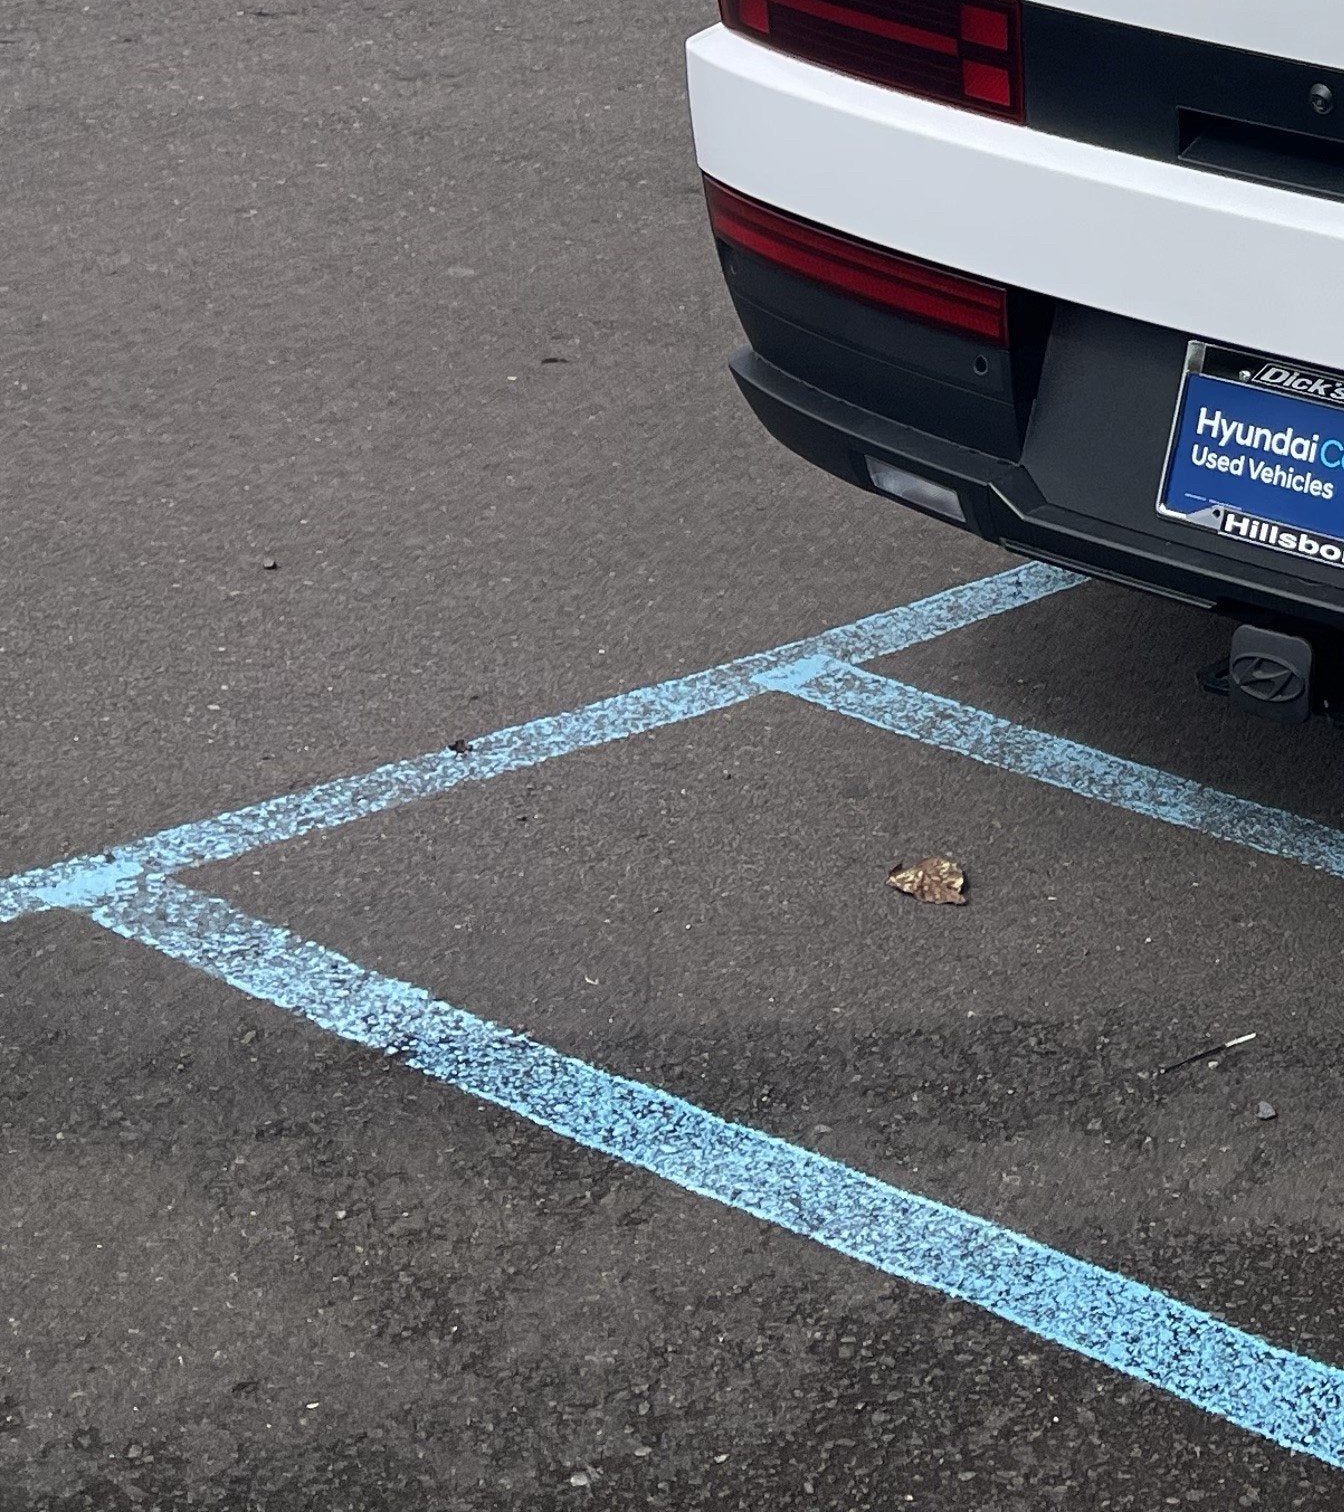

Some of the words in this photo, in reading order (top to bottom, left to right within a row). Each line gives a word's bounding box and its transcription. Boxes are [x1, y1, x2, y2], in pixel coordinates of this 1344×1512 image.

[1196, 406, 1320, 463] Hyundai
[1191, 444, 1246, 477] Used
[1248, 458, 1335, 500] Vehicles
